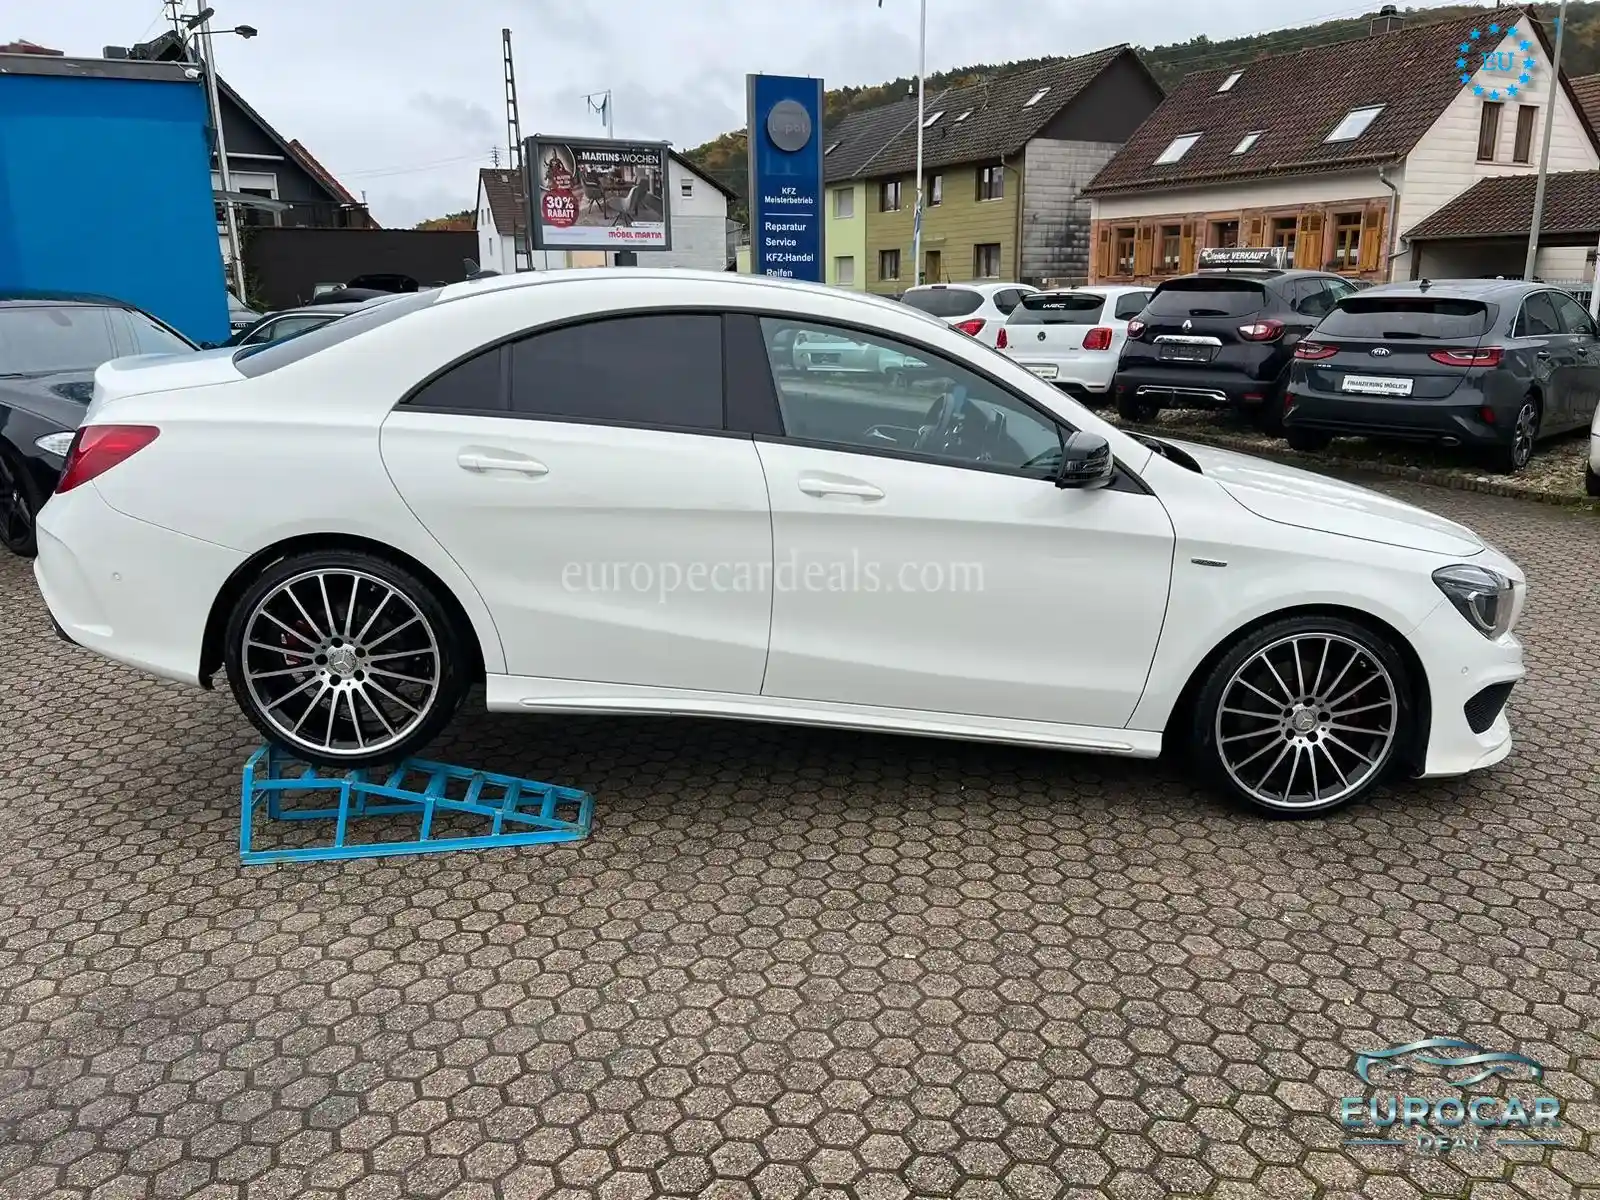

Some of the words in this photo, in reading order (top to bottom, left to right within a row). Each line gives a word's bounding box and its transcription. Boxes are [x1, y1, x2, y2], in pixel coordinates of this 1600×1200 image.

[581, 151, 659, 164] MARTINS-WOCHEN
[781, 187, 797, 195] KFZ
[546, 196, 574, 209] 30%
[764, 196, 814, 204] Meisterbetrieb
[547, 209, 575, 218] RABATT
[765, 221, 807, 232] Reparatur
[765, 237, 797, 246] Service
[766, 253, 814, 262] KFZ-Handel
[1231, 251, 1269, 260] VERKAUFT
[766, 268, 793, 278] Reifen
[1372, 348, 1389, 356] KIA
[1347, 380, 1383, 388] FINANZIERUNG
